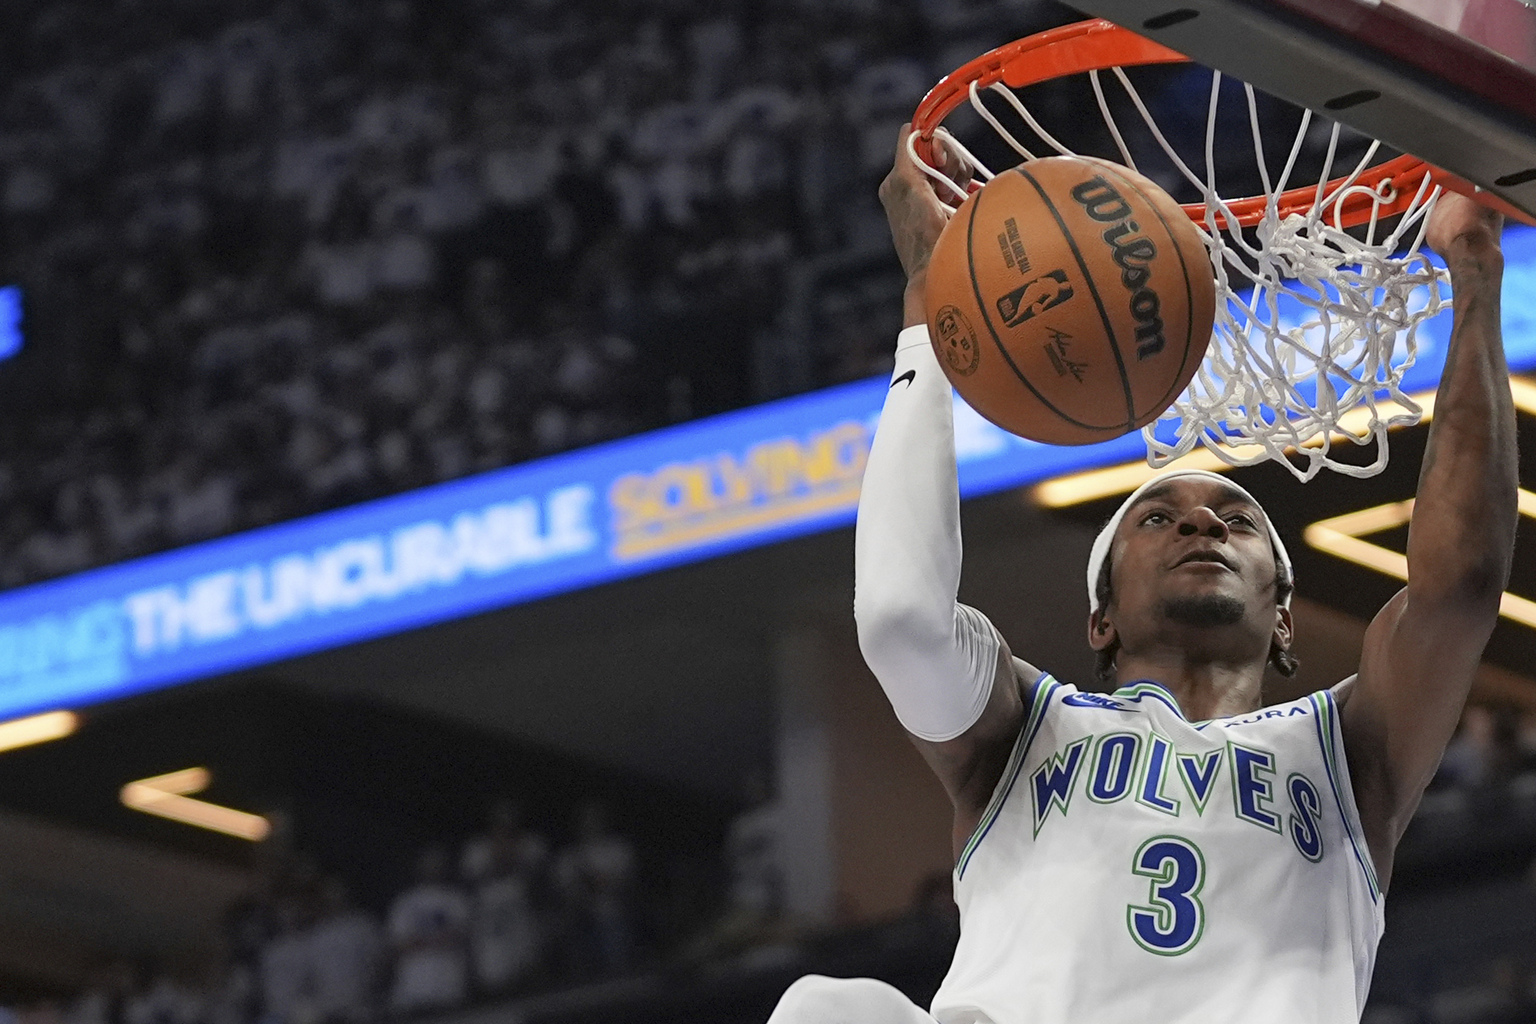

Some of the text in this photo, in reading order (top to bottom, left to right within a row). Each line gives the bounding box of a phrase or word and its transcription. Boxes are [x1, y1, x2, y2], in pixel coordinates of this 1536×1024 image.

[1069, 174, 1167, 362] Wilson
[608, 421, 870, 530] SOLVING
[127, 569, 240, 657] THE
[243, 484, 597, 629] UNCURABLE
[1029, 730, 1324, 864] WOLVES
[1126, 834, 1207, 958] 3
